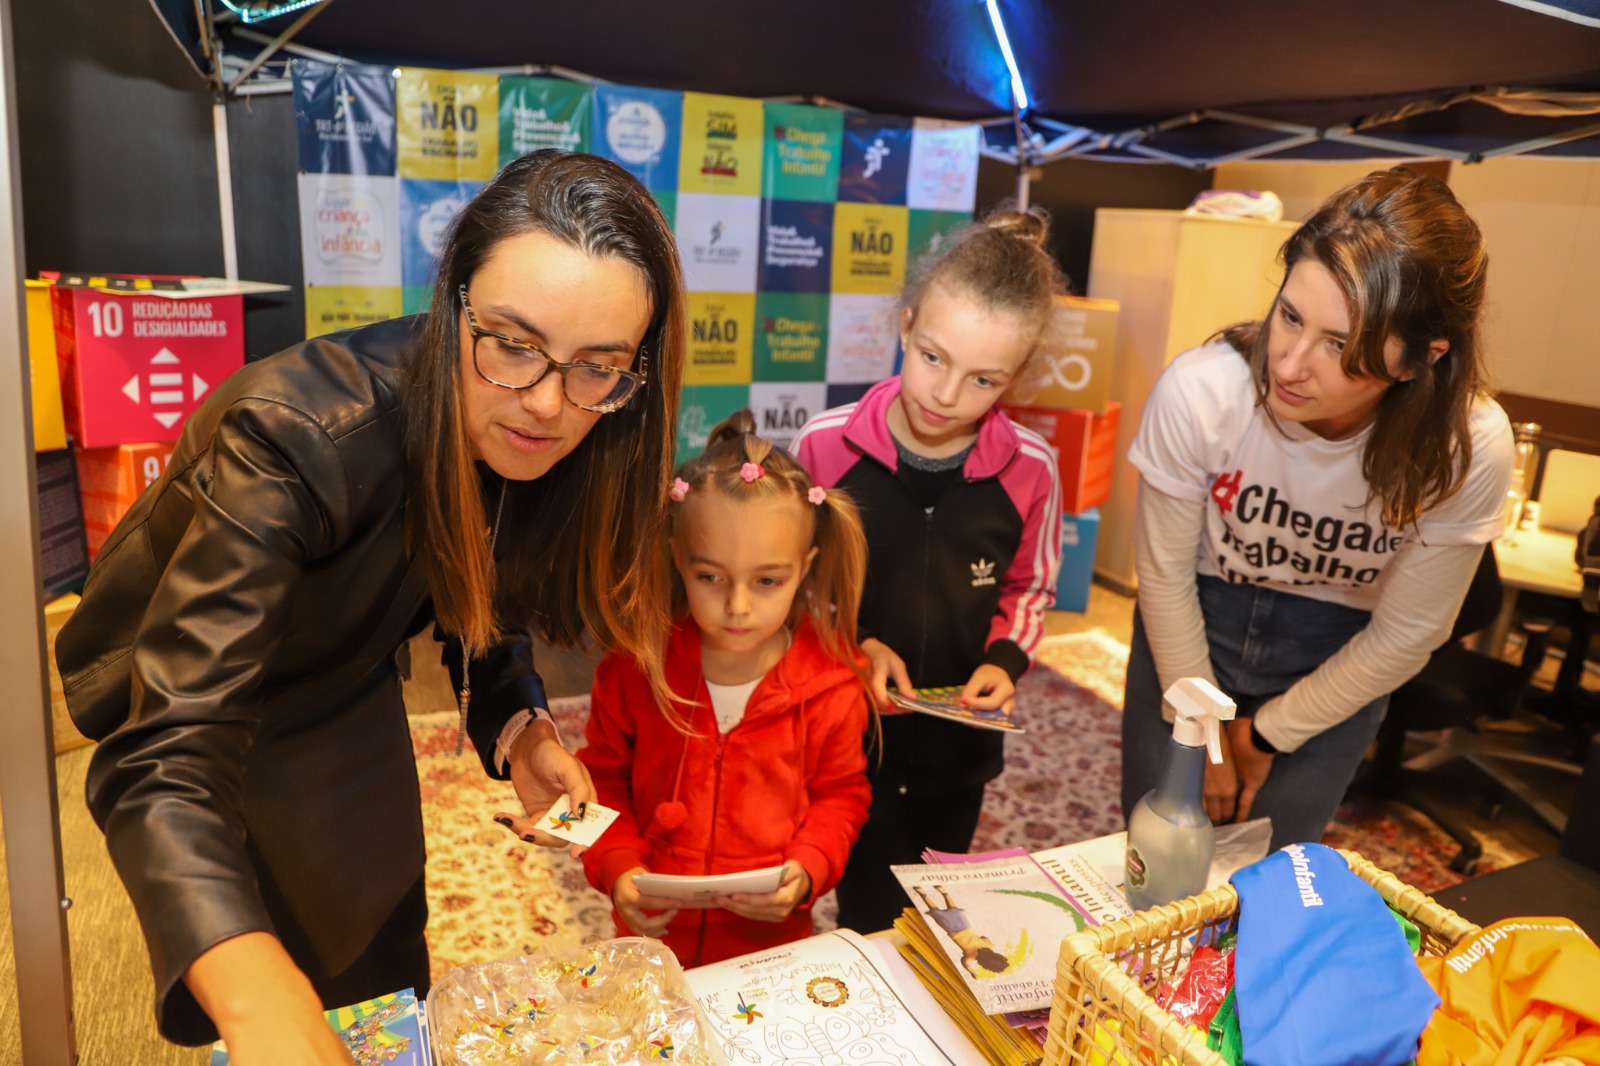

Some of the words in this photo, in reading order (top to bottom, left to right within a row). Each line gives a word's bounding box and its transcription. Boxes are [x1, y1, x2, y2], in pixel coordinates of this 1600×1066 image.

[421, 95, 478, 132] NÃO
[318, 208, 370, 226] criança
[320, 233, 382, 253] infância
[850, 225, 893, 255] NÃO
[87, 301, 123, 337] 10
[132, 299, 188, 319] REDUÇÃO
[189, 302, 213, 319] DAS
[133, 320, 227, 337] DESIGUALDADES
[693, 312, 738, 344] NÃO
[763, 401, 807, 429] NÃO
[143, 455, 160, 480] 9
[919, 874, 960, 883] Olhar
[963, 867, 1027, 880] Primeiro
[1041, 859, 1104, 913] Infantil
[1068, 858, 1116, 904] Respostas
